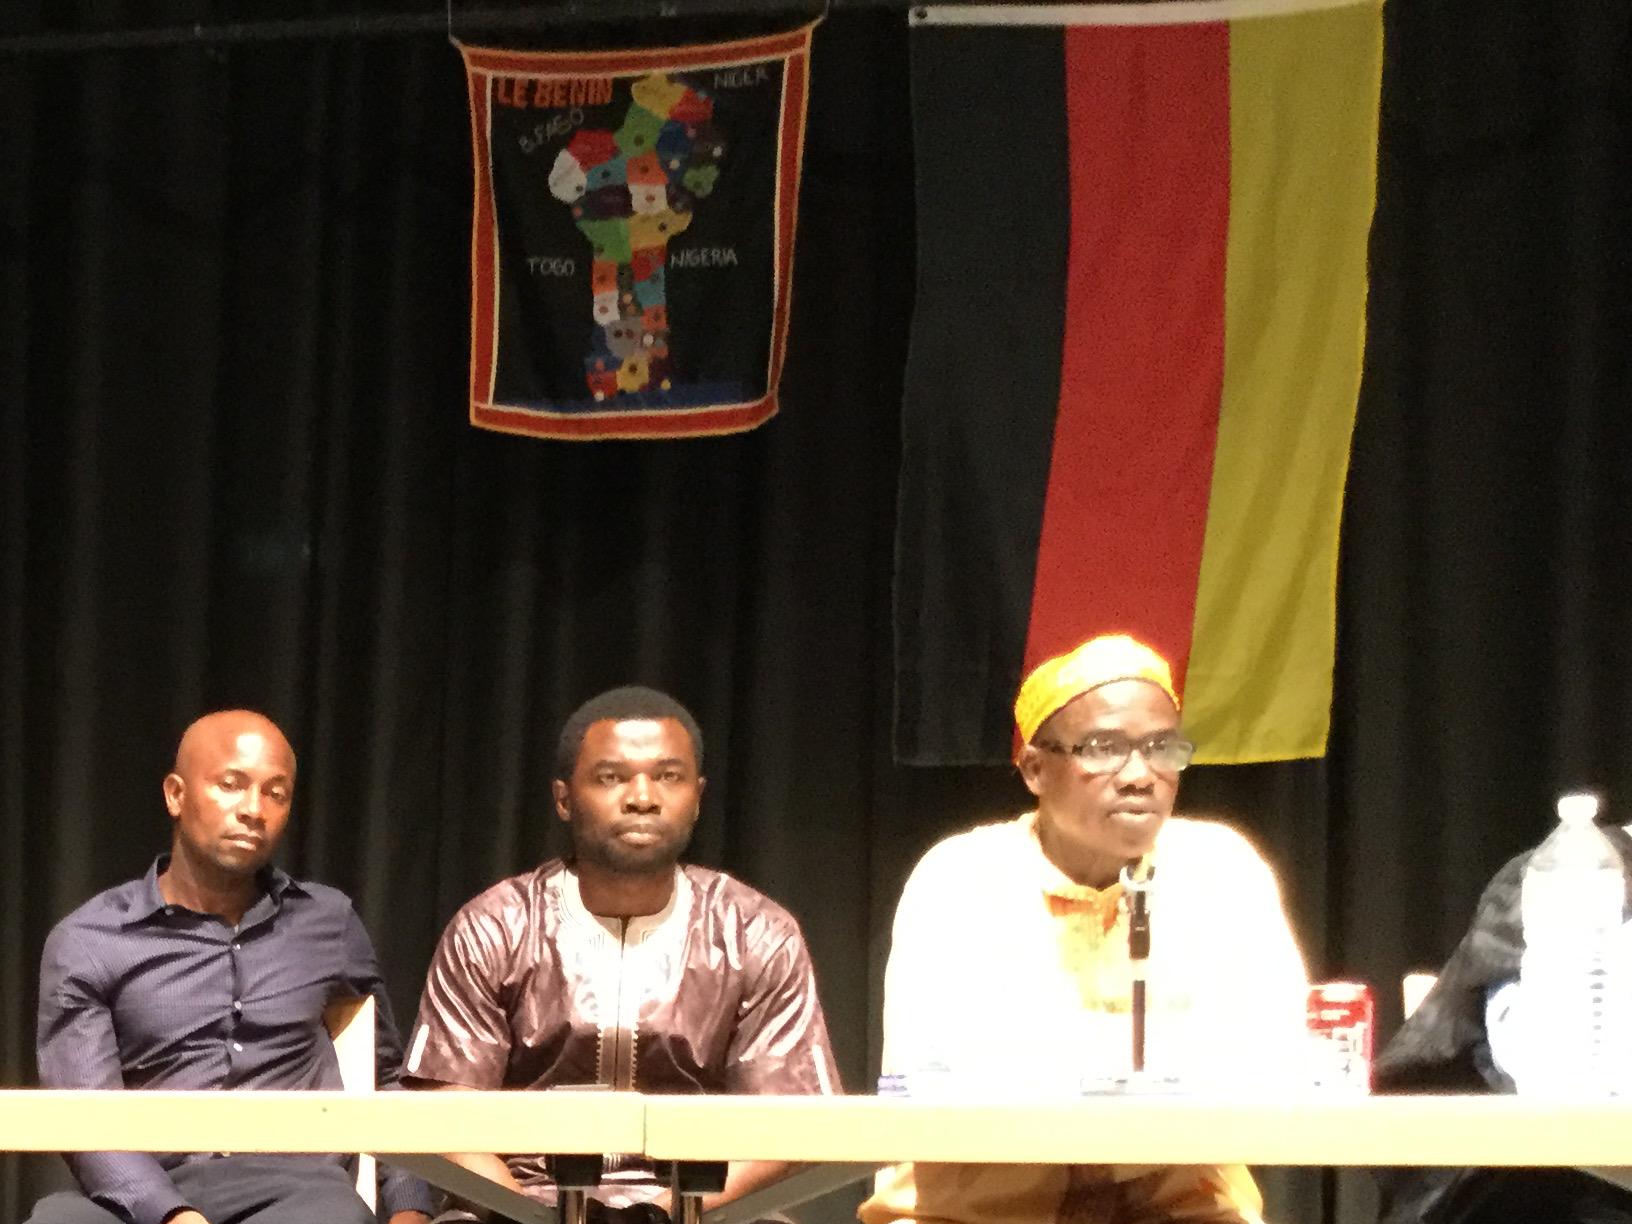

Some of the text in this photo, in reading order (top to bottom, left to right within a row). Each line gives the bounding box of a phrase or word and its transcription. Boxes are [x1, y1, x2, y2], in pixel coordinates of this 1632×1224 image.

[497, 77, 529, 109] LE
[527, 256, 575, 276] TOGO
[670, 247, 739, 268] NIGERIA
